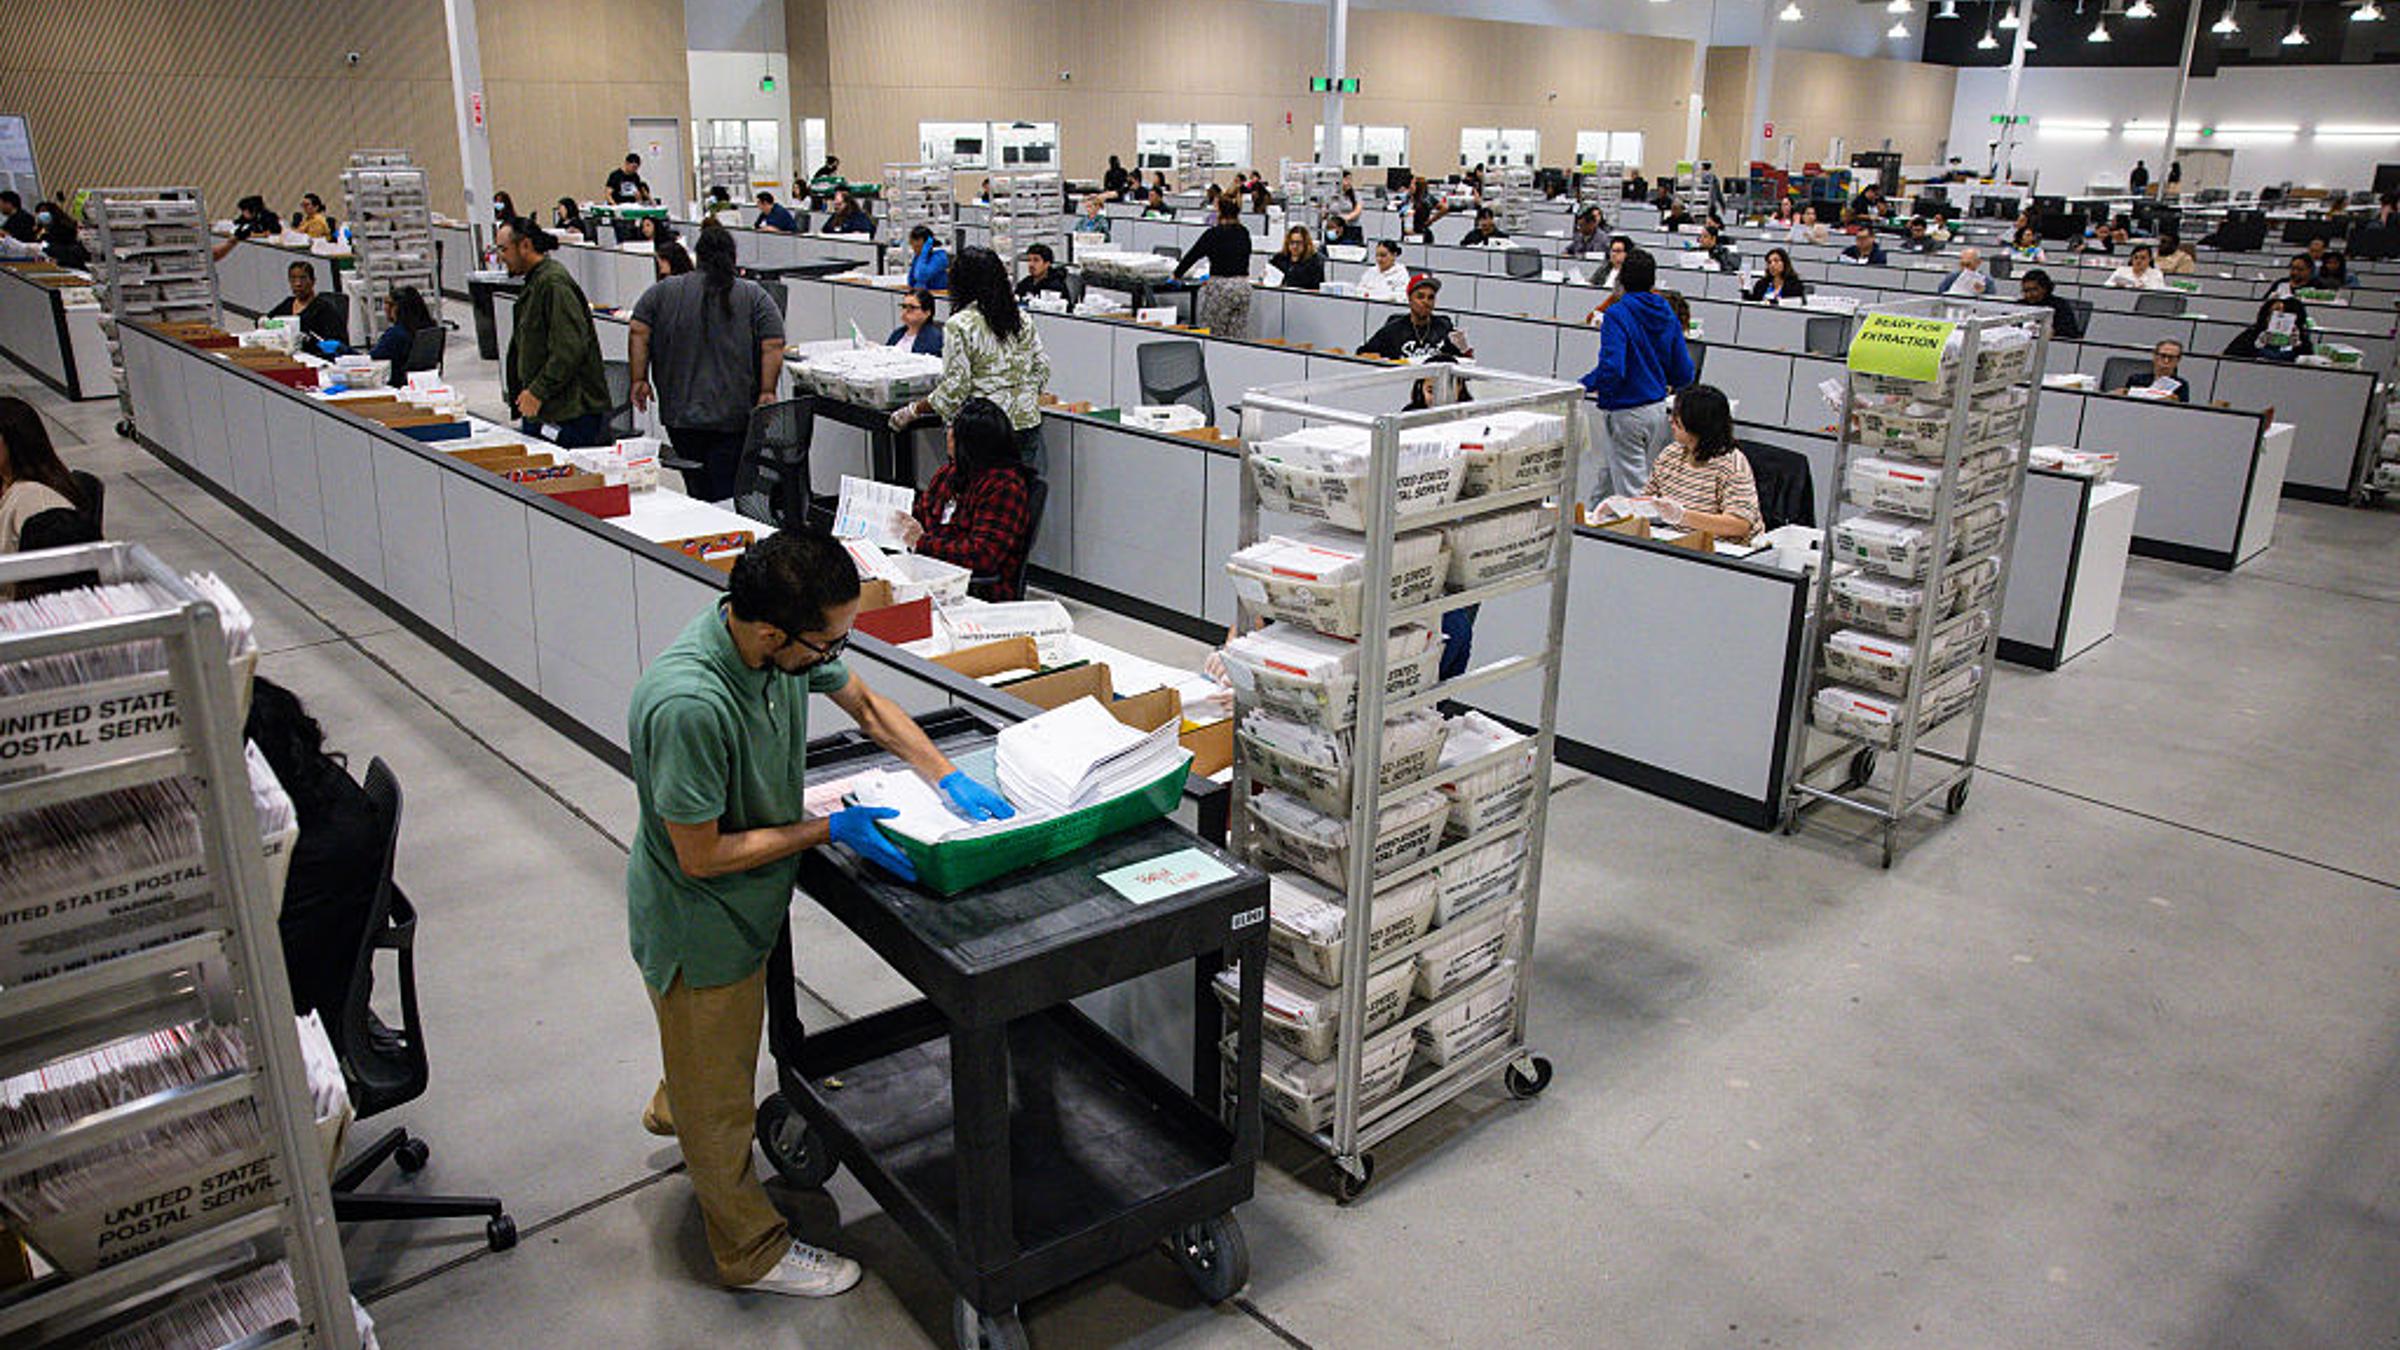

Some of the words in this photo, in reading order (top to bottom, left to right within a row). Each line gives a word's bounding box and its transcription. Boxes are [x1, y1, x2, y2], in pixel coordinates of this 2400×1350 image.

[1861, 330, 1939, 349] EXTRACTION
[0, 705, 91, 737] NITED
[99, 690, 177, 719] STATE
[0, 730, 91, 759] OSTAL
[98, 711, 182, 742] SERVI
[0, 904, 48, 927] ITED
[54, 884, 130, 915] STATES
[134, 864, 208, 895] POSTAL
[98, 1206, 192, 1249] POSTAL
[200, 1174, 282, 1212] SERVI
[104, 1186, 193, 1226] UNITED
[200, 1155, 276, 1194] STATE
